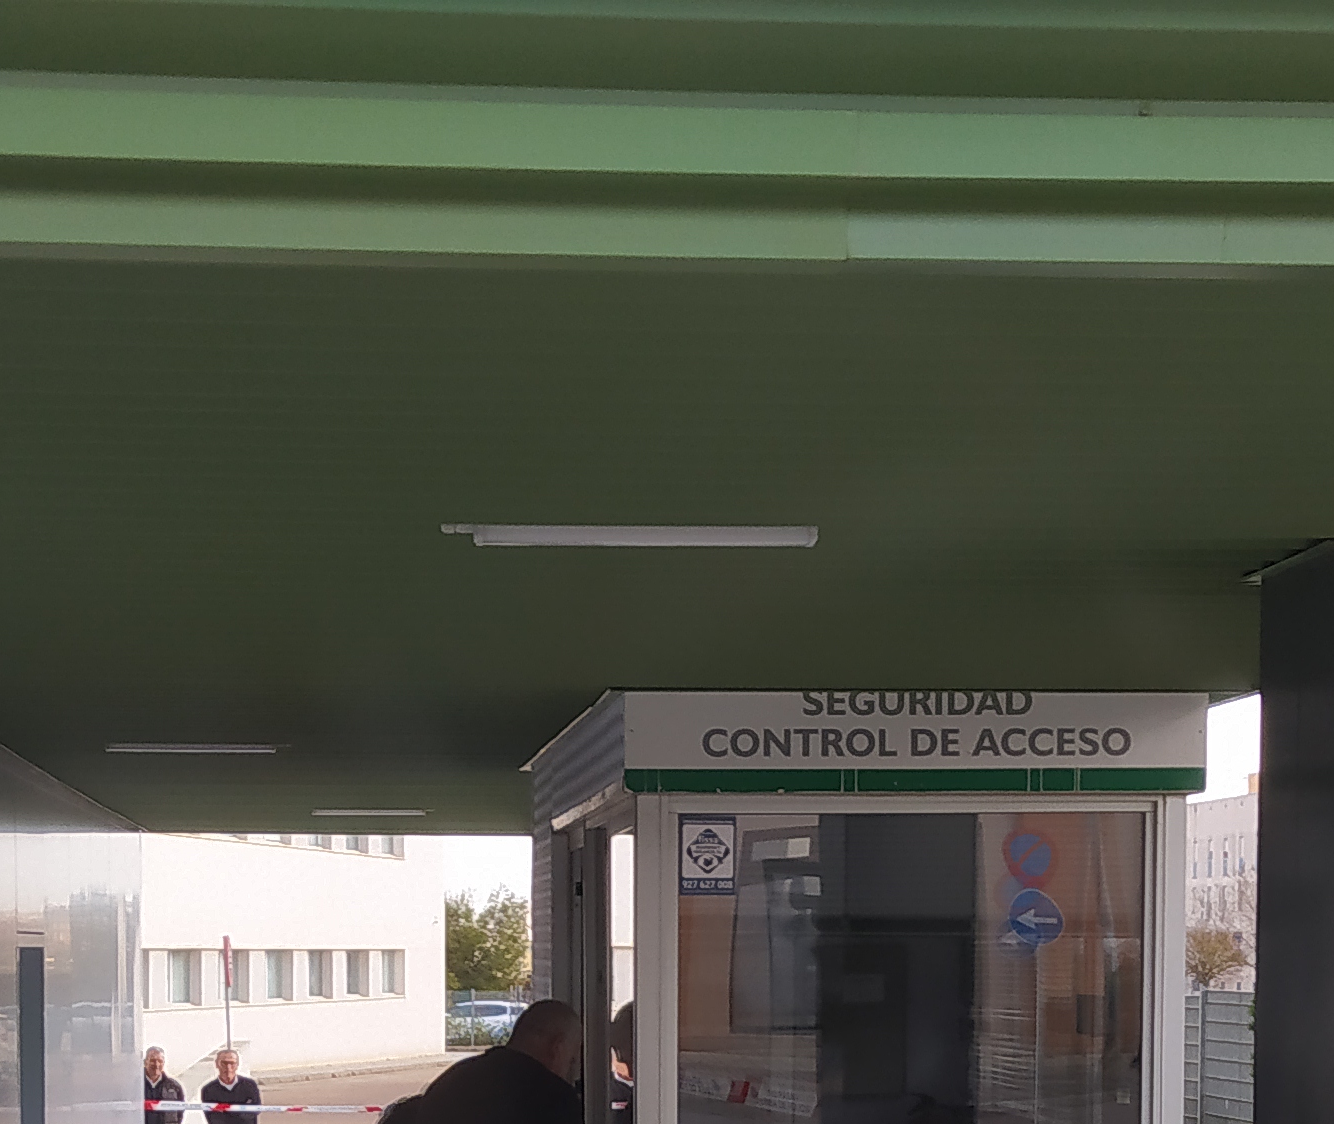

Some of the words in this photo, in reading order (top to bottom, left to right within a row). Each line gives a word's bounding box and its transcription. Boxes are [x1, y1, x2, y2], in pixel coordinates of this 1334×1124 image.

[801, 690, 1034, 716] SEGURIDAD
[702, 727, 897, 758] CONTROL
[911, 727, 961, 757] DE
[971, 726, 1133, 757] ACCESO
